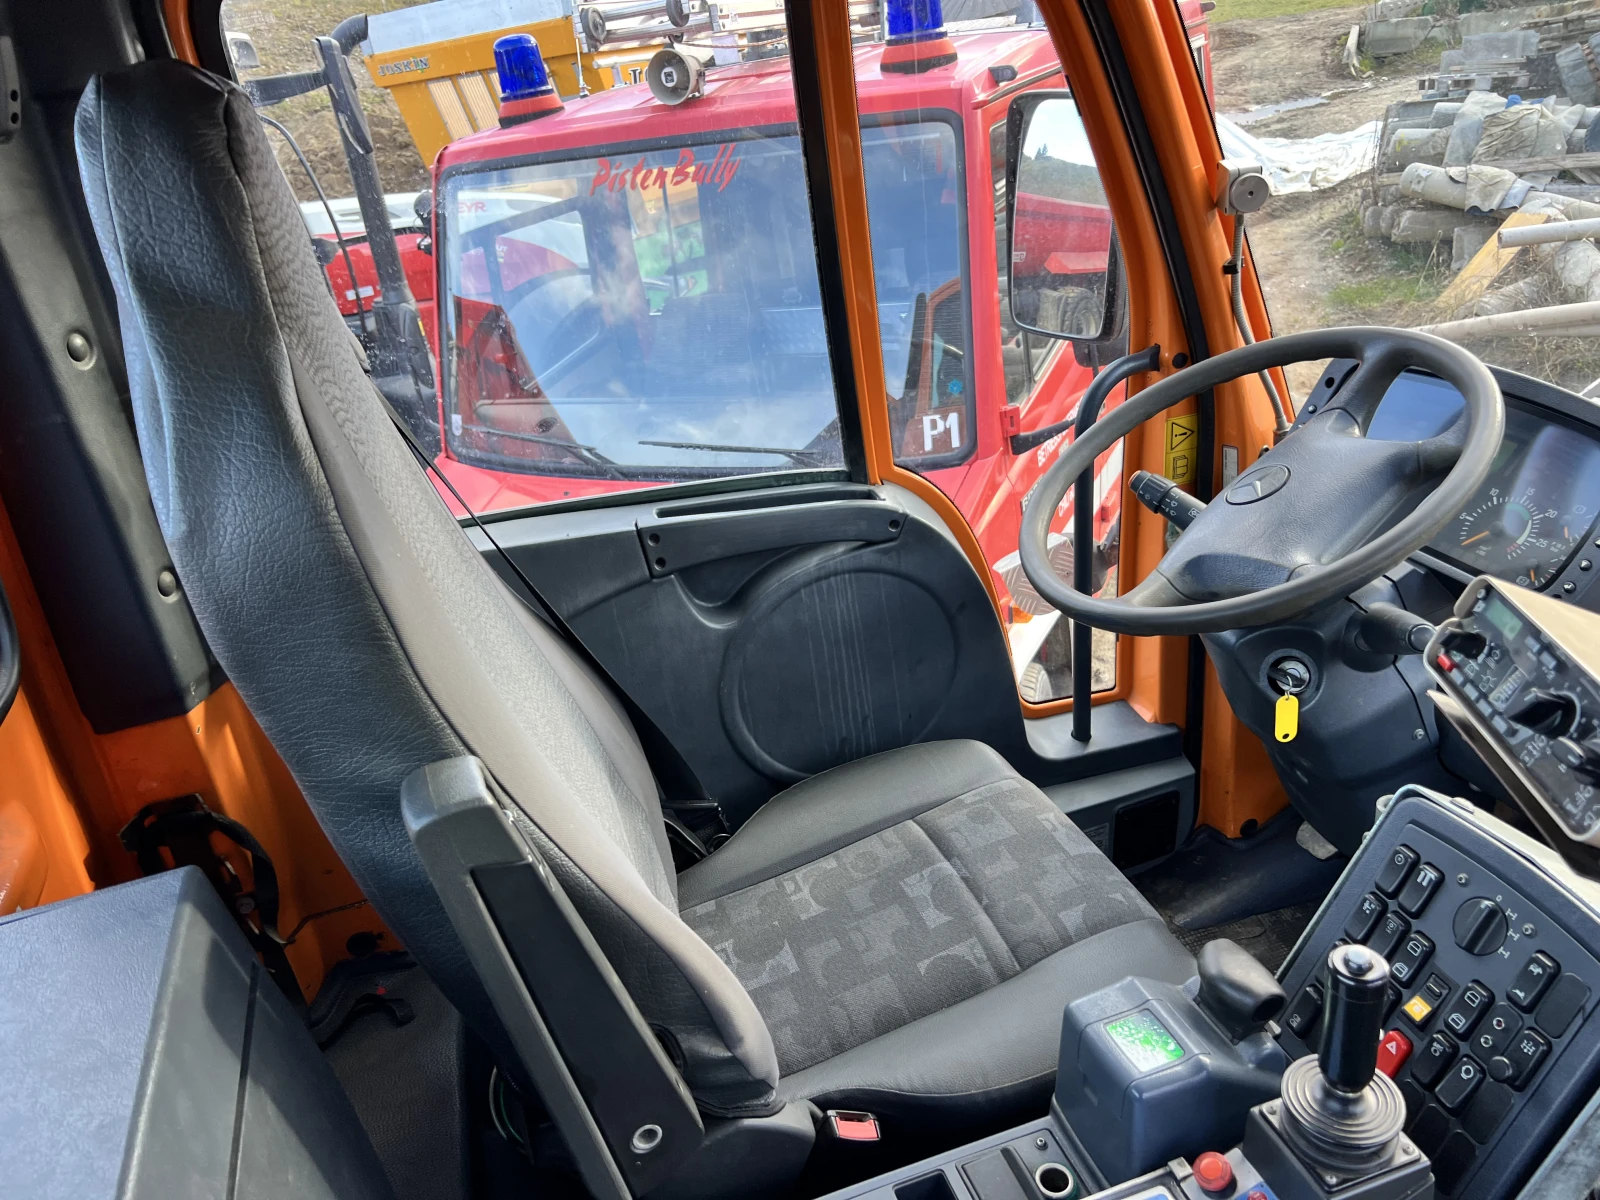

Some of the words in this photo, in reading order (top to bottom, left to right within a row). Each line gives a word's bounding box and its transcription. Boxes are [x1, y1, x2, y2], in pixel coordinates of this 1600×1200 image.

[378, 57, 429, 76] JOSKIN
[589, 143, 741, 197] PistenBully
[923, 412, 960, 451] P1
[1488, 487, 1499, 497] 10
[1526, 487, 1536, 496] 15
[1545, 509, 1558, 519] 20
[1536, 538, 1549, 548] 25
